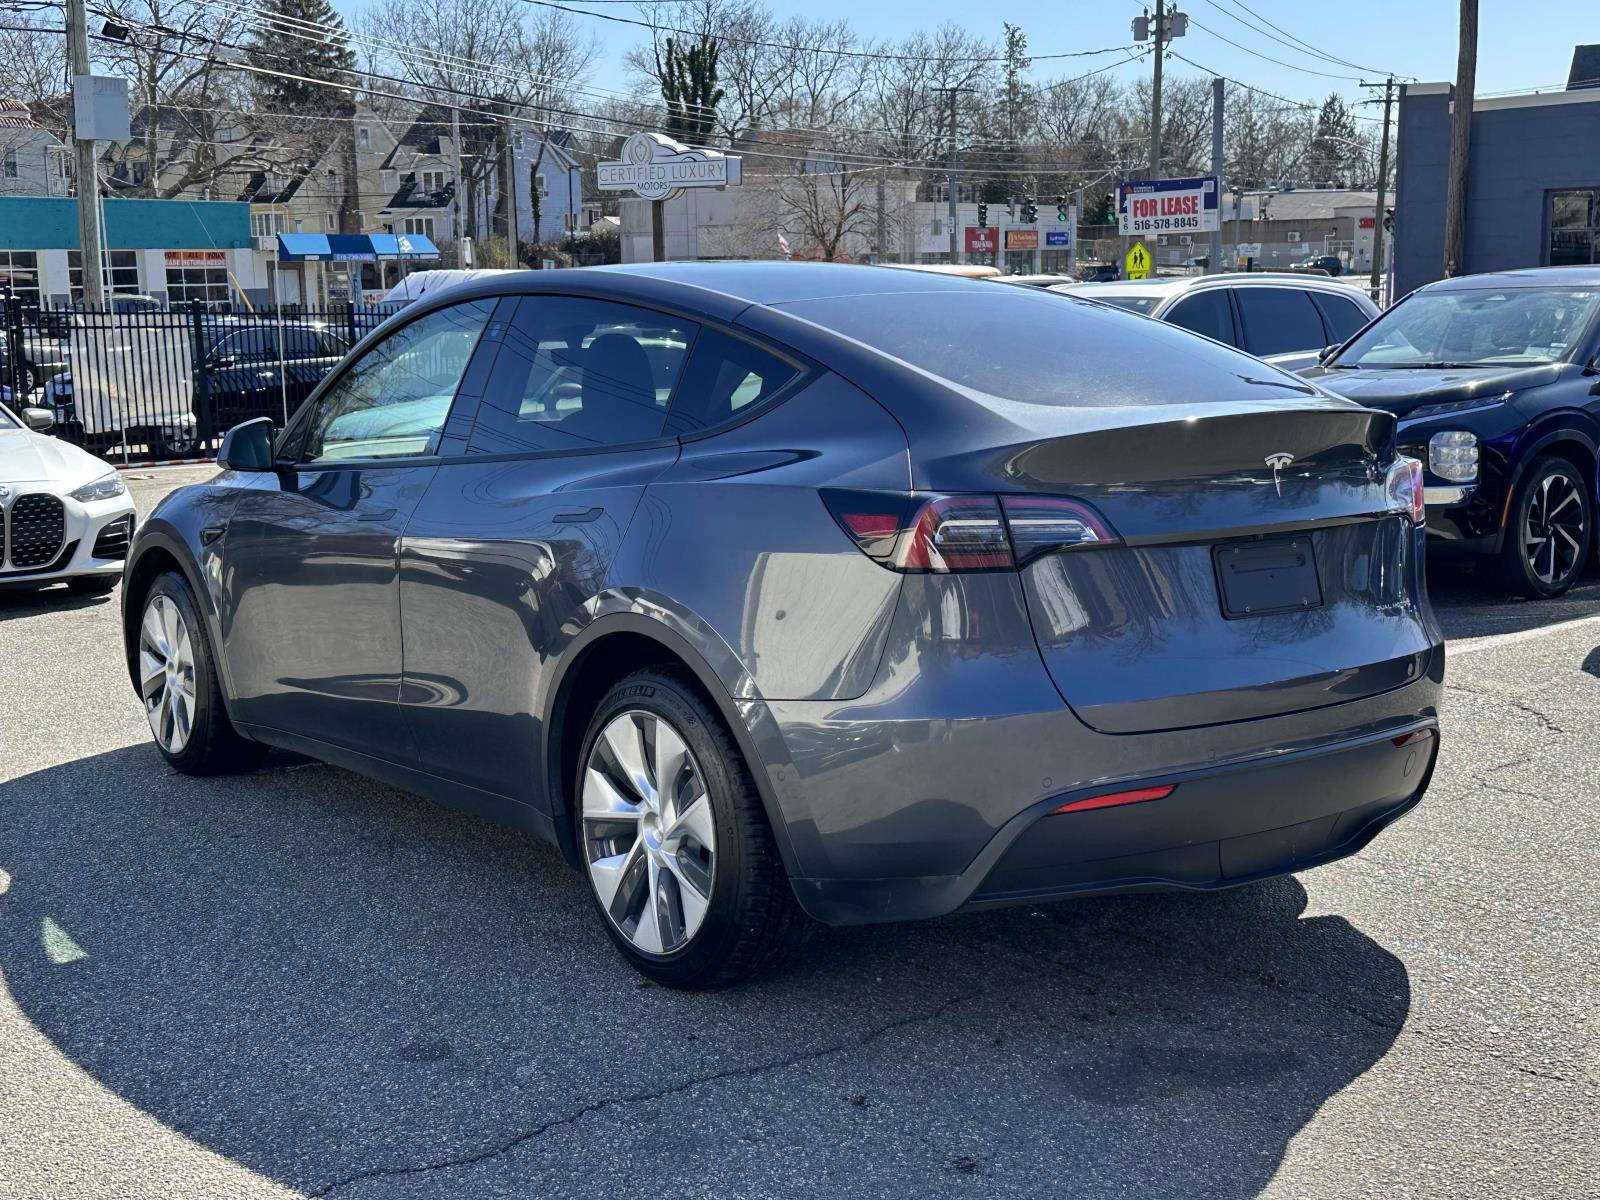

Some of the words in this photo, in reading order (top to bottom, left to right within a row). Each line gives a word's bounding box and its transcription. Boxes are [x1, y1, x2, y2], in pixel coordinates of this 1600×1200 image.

[599, 165, 666, 182] CERTIFIED
[672, 163, 724, 179] LUXURY
[637, 181, 668, 190] MOTORS
[1133, 199, 1157, 218] FOR
[1161, 195, 1199, 216] LEASE
[1134, 216, 1198, 231] 516-578-8845
[187, 251, 199, 259] ALL
